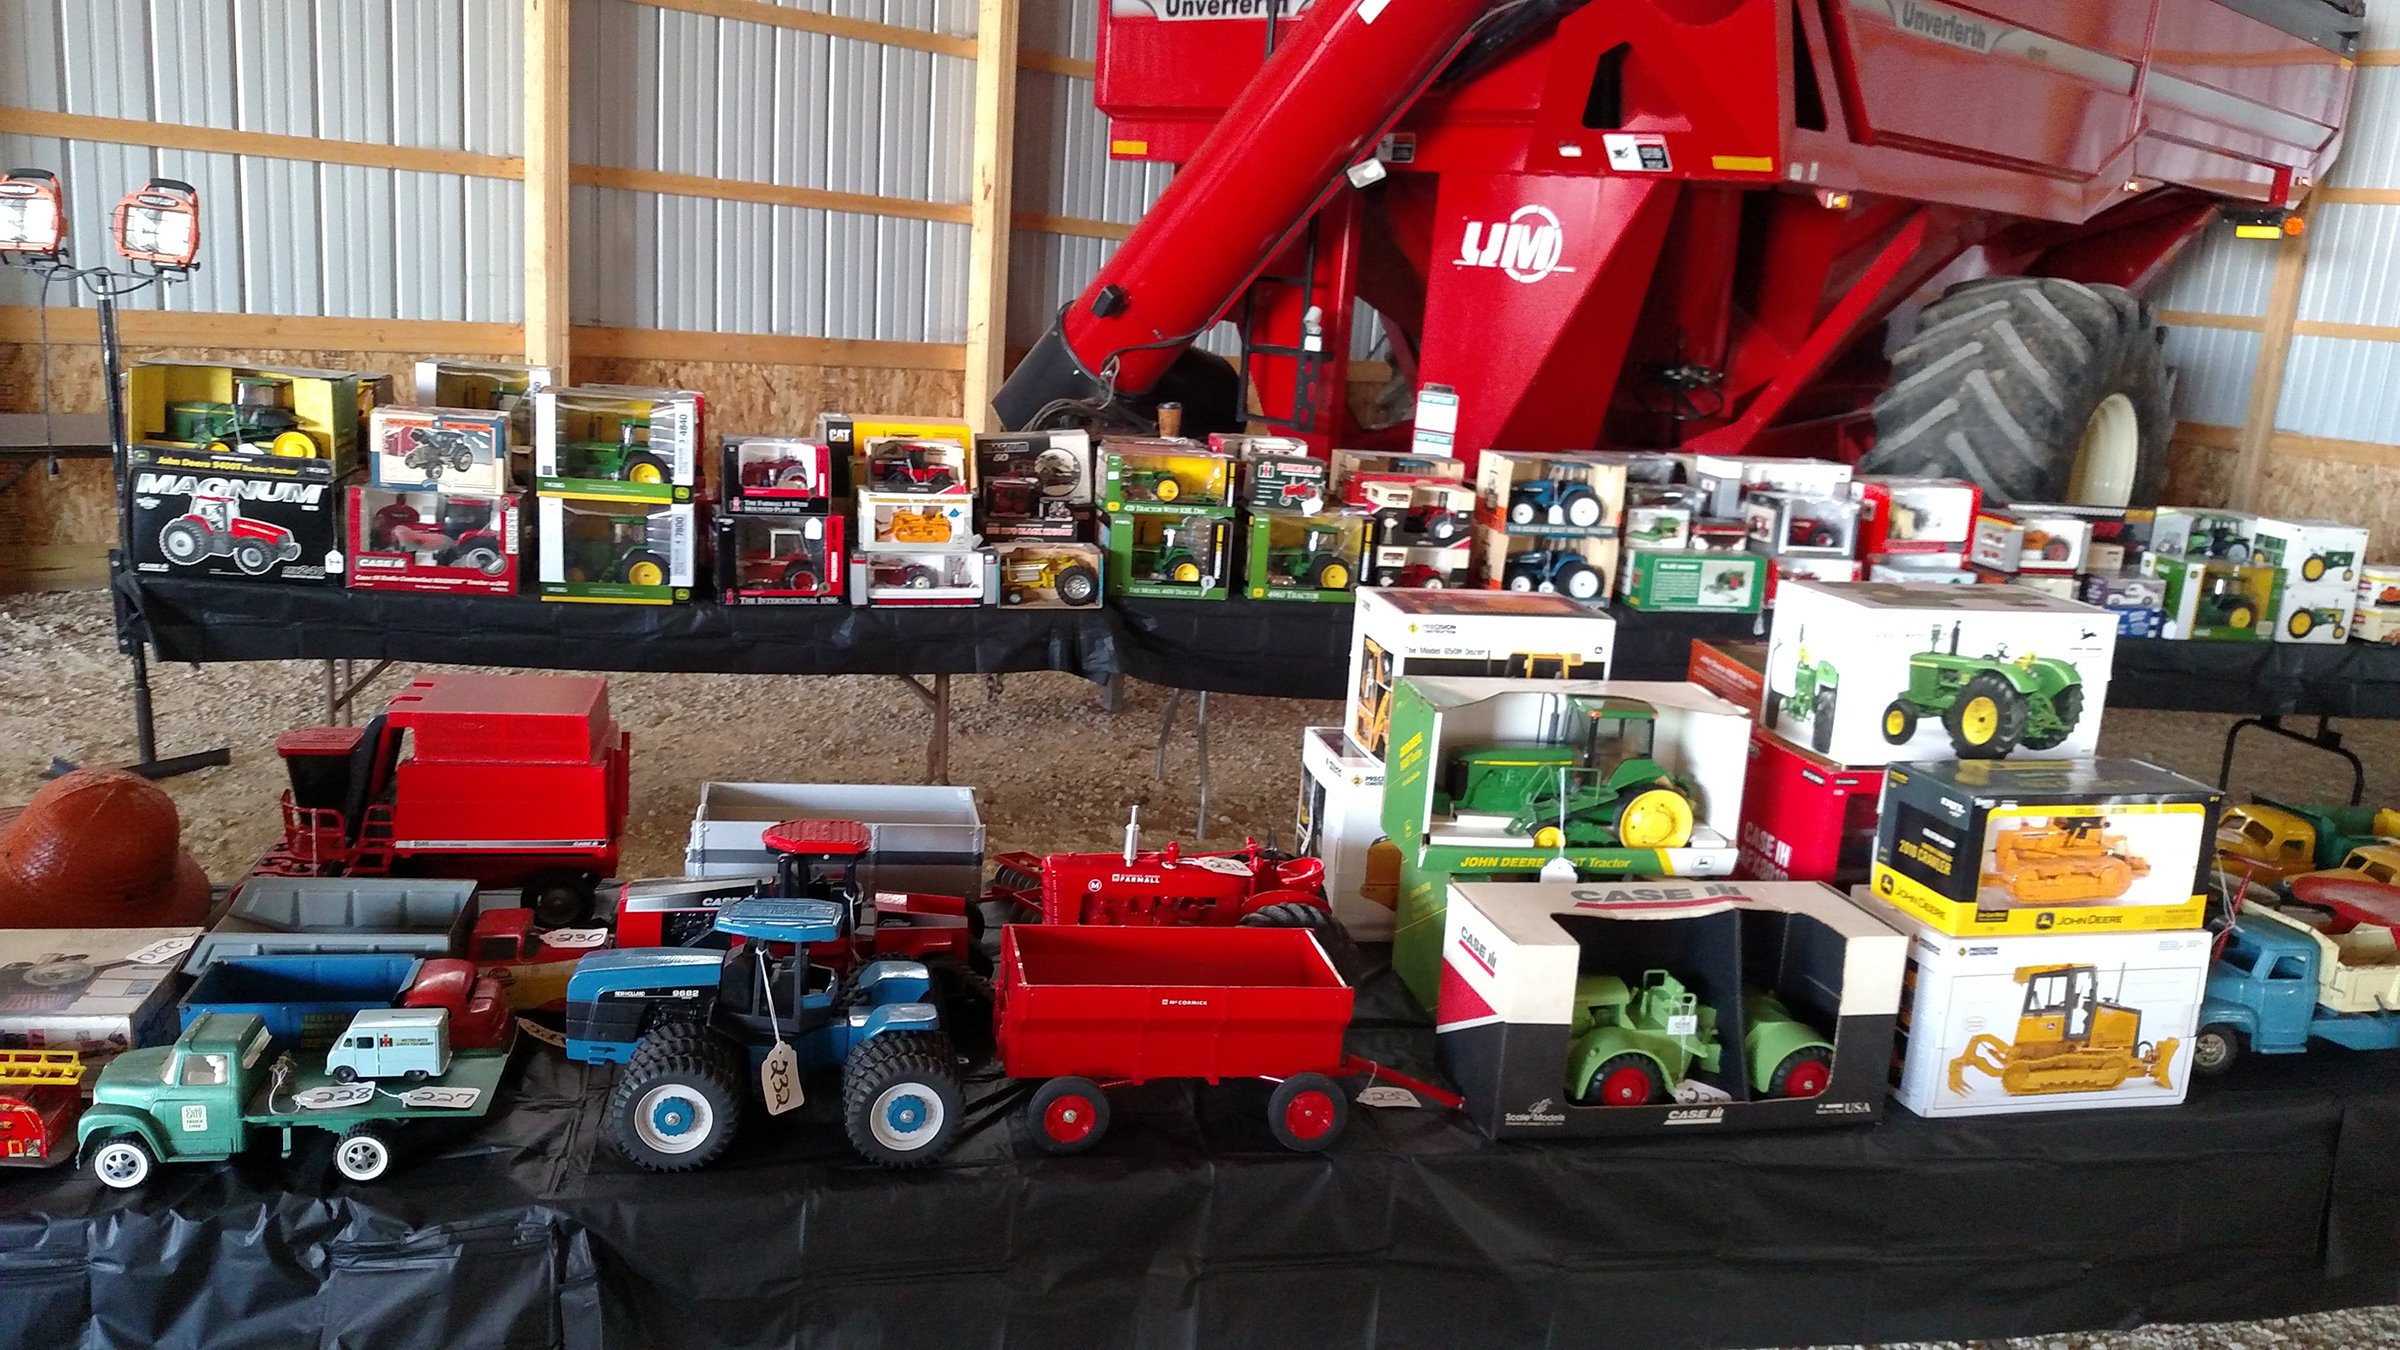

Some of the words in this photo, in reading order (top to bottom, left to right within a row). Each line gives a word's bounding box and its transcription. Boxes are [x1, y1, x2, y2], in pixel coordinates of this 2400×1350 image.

[1903, 1, 1987, 50] Unverferth
[679, 414, 688, 437] 4840
[829, 429, 850, 442] CAT
[136, 473, 326, 504] MAGNUM
[675, 516, 684, 536] 7800
[359, 559, 391, 568] CASE
[1460, 857, 1498, 868] JOHN
[1500, 857, 1546, 868] DEERE
[1589, 857, 1631, 868] Tractor
[1120, 876, 1160, 884] FARMALL
[1570, 888, 1693, 902] CASE
[2057, 916, 2088, 926] JOHN
[2089, 915, 2123, 925] DEERE
[556, 933, 604, 943] 230
[1461, 926, 1487, 959] CASE
[770, 1060, 790, 1111] 232
[313, 1087, 373, 1103] 228
[413, 1091, 475, 1104] 227
[1668, 1109, 1708, 1119] CASE
[1845, 1102, 1871, 1113] USA
[1505, 1113, 1530, 1121] Scale
[1533, 1113, 1565, 1121] Models
